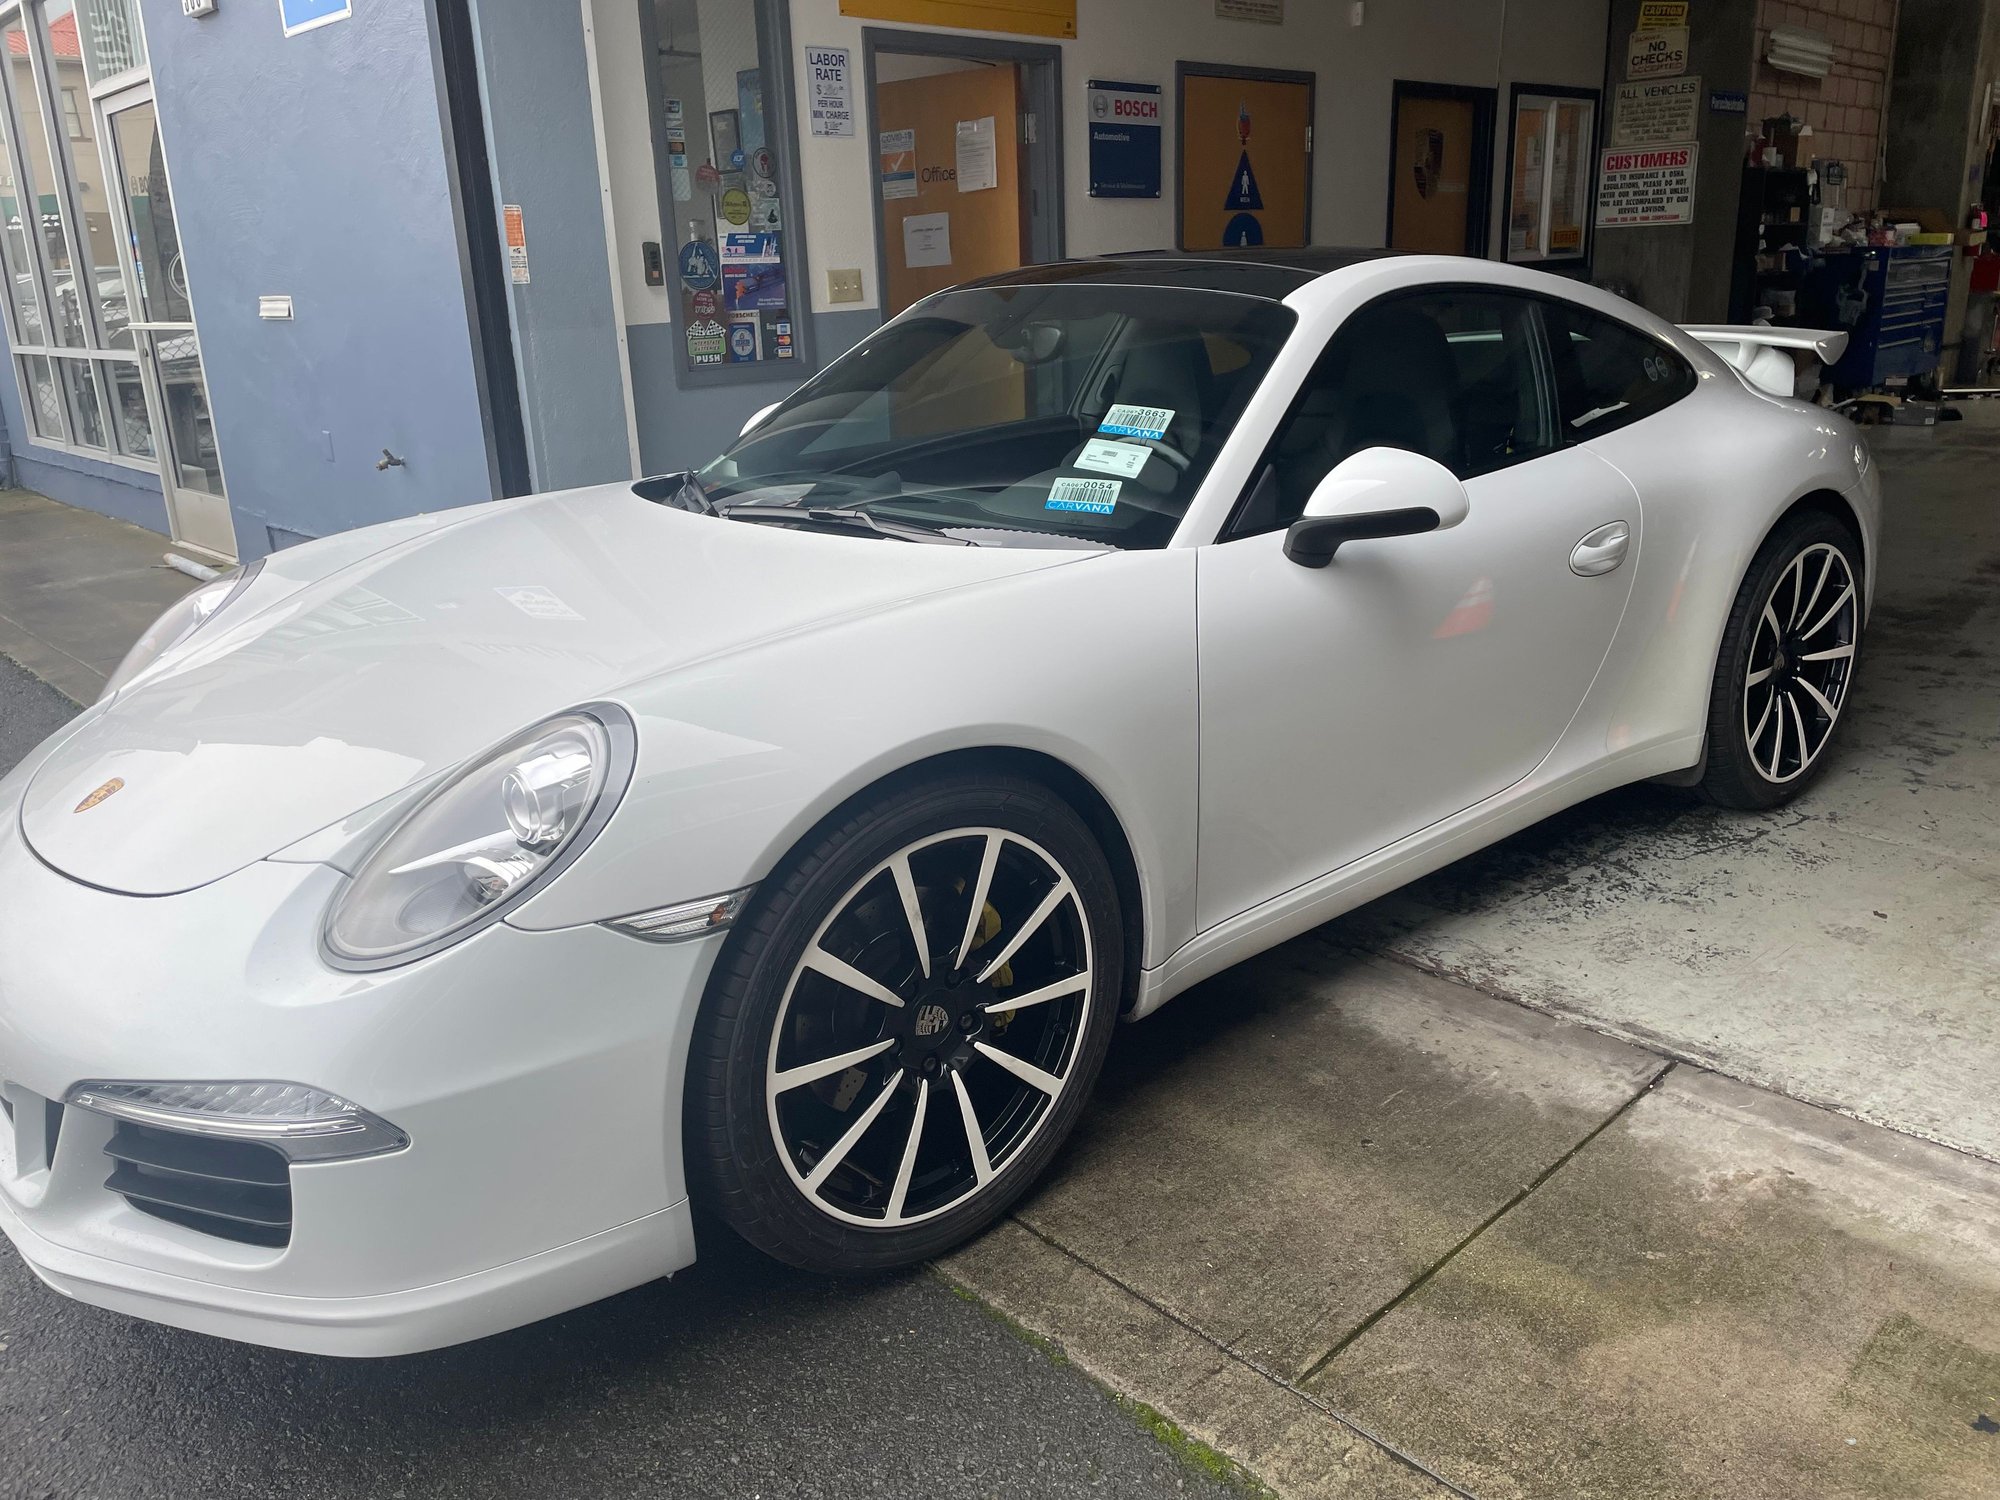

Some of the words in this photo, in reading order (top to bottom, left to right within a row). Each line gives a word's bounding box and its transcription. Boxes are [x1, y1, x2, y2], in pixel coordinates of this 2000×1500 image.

[1644, 5, 1684, 17] CAUTION
[1648, 41, 1667, 53] NO
[809, 52, 846, 67] LABOR
[1631, 50, 1683, 66] CHECKS
[815, 68, 842, 82] RATE
[1620, 89, 1638, 100] ALL
[1644, 82, 1696, 97] VEHICLES
[817, 99, 828, 108] PER
[829, 100, 844, 109] HOUR
[1114, 99, 1158, 118] BOSCH
[825, 110, 850, 120] CHARGE
[1093, 131, 1131, 142] Automotive
[1606, 150, 1689, 170] CUSTOMERS
[921, 166, 956, 183] Office
[1606, 174, 1617, 182] DUE
[1628, 172, 1659, 181] INSURANCE
[1642, 180, 1662, 188] PLEASE
[1675, 178, 1687, 186] NOT
[1618, 190, 1630, 198] OUR
[1632, 189, 1649, 197] WORK
[1652, 188, 1667, 196] AREA
[1669, 186, 1690, 195] UNLESS
[1599, 199, 1611, 207] YOU
[1625, 196, 1664, 205] ACCOMPANIED
[1676, 195, 1689, 203] OUR
[1618, 206, 1639, 215] SERVICE
[696, 354, 721, 363] PUSH
[1101, 425, 1159, 439] CARVANA
[1048, 502, 1110, 513] CARVANA
